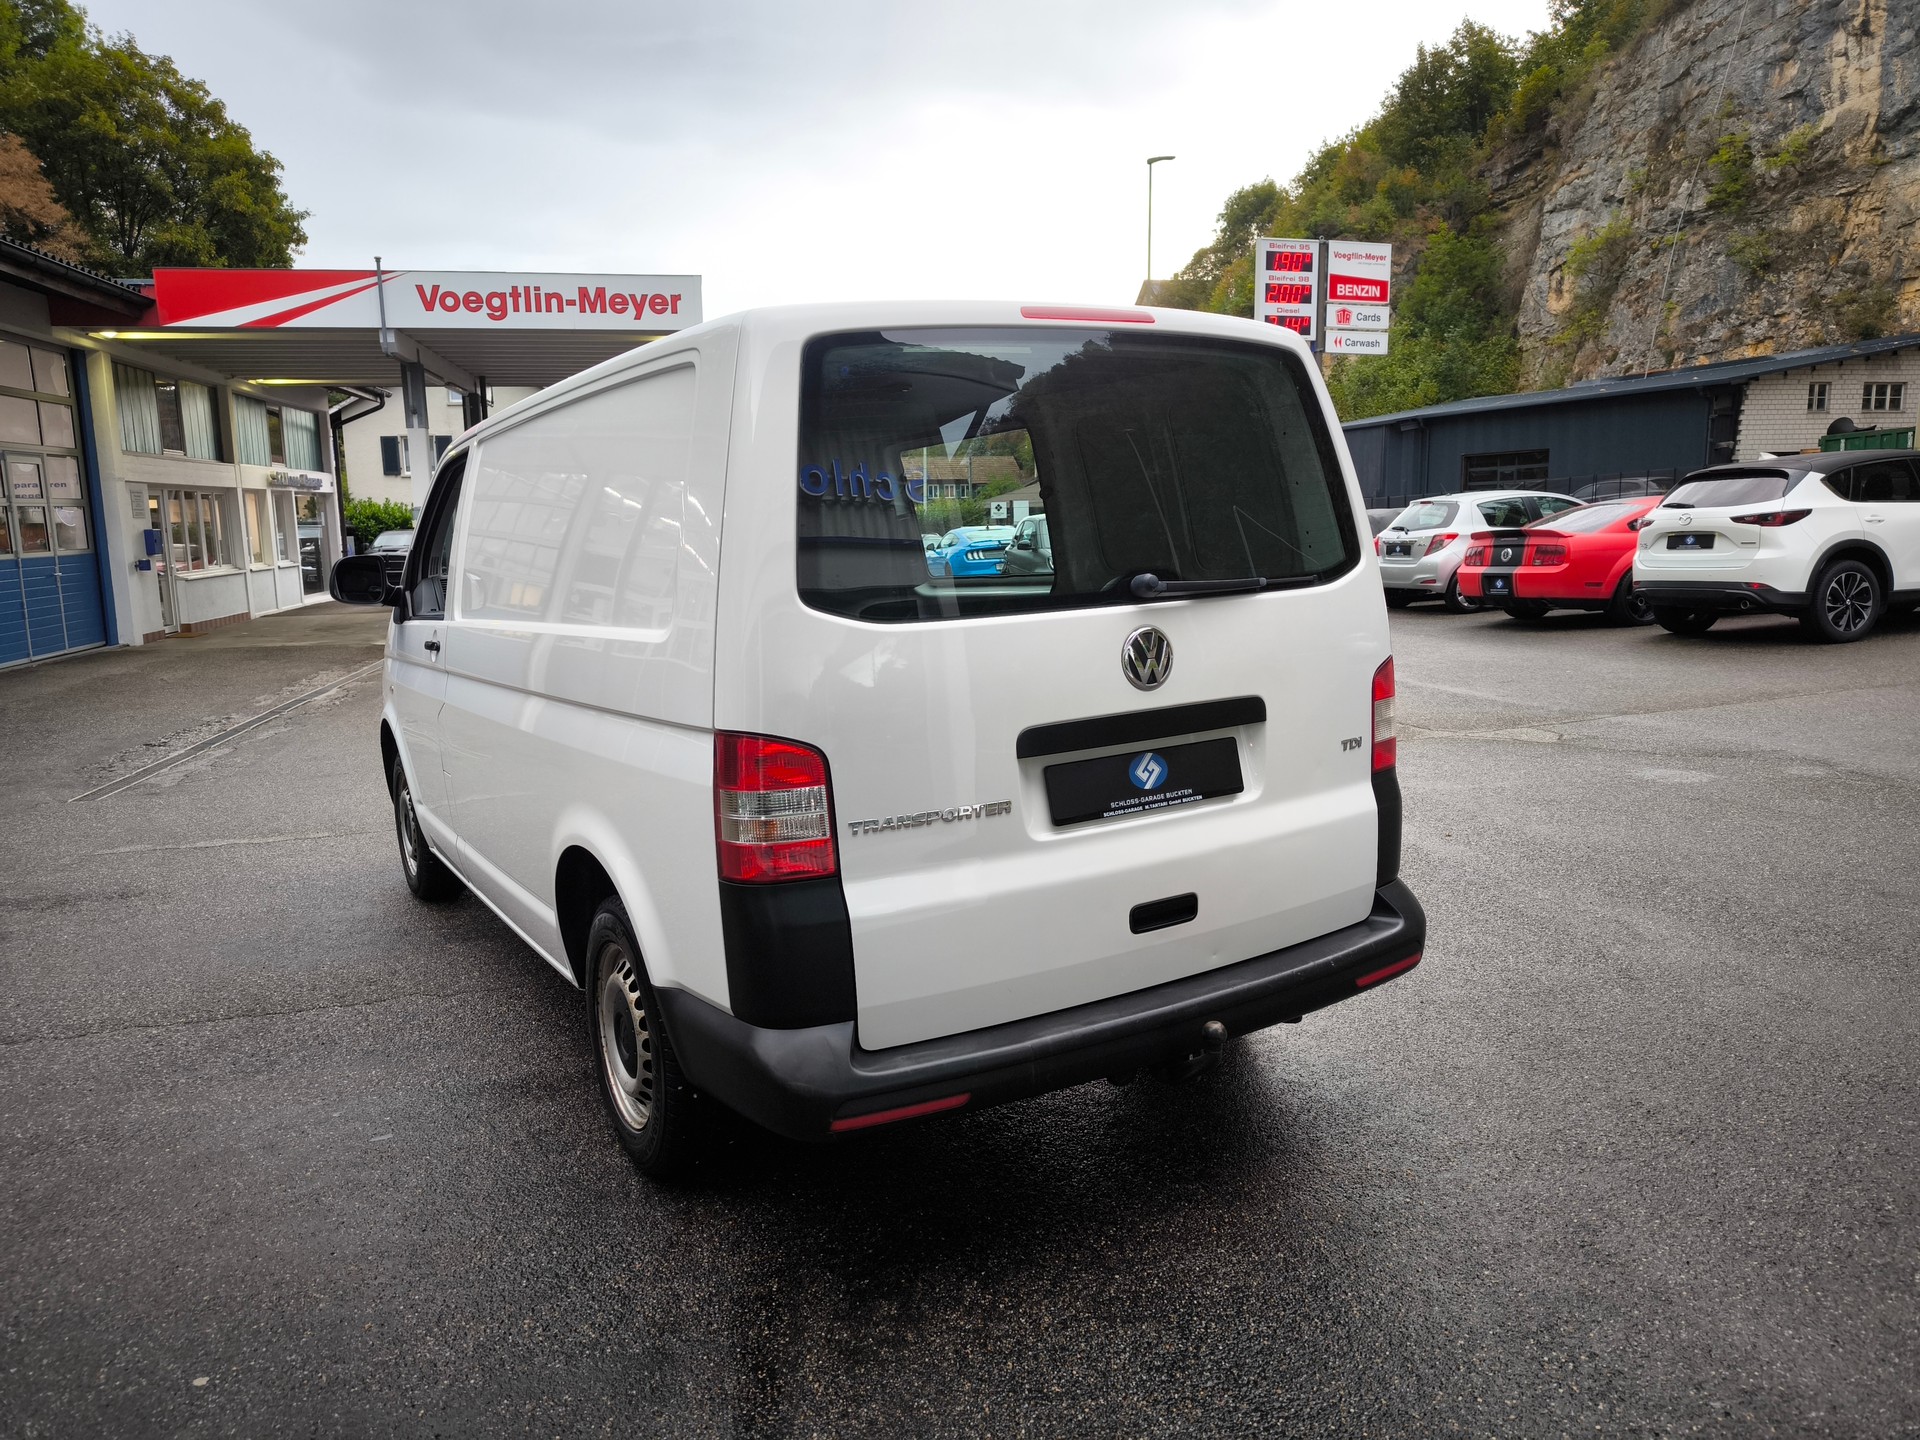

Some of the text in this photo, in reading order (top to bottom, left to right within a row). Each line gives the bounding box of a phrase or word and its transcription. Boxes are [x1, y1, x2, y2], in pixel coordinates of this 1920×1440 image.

[1269, 242, 1296, 250] Bleifrei
[1333, 251, 1387, 262] Voegtlin-Meyer
[1336, 283, 1380, 297] BENZIN
[415, 284, 682, 321] Voegtlin-Meyer
[1356, 312, 1381, 322] Cards
[1345, 338, 1380, 348] Carwash
[1341, 736, 1362, 752] TDI
[1110, 788, 1193, 808] SCHLOSS-GARAGE BUCKTEN
[1103, 806, 1143, 817] SCHLOSS-GARAGE
[1182, 795, 1203, 804] BUCKTEN
[848, 800, 1012, 835] TRANSPORTER
